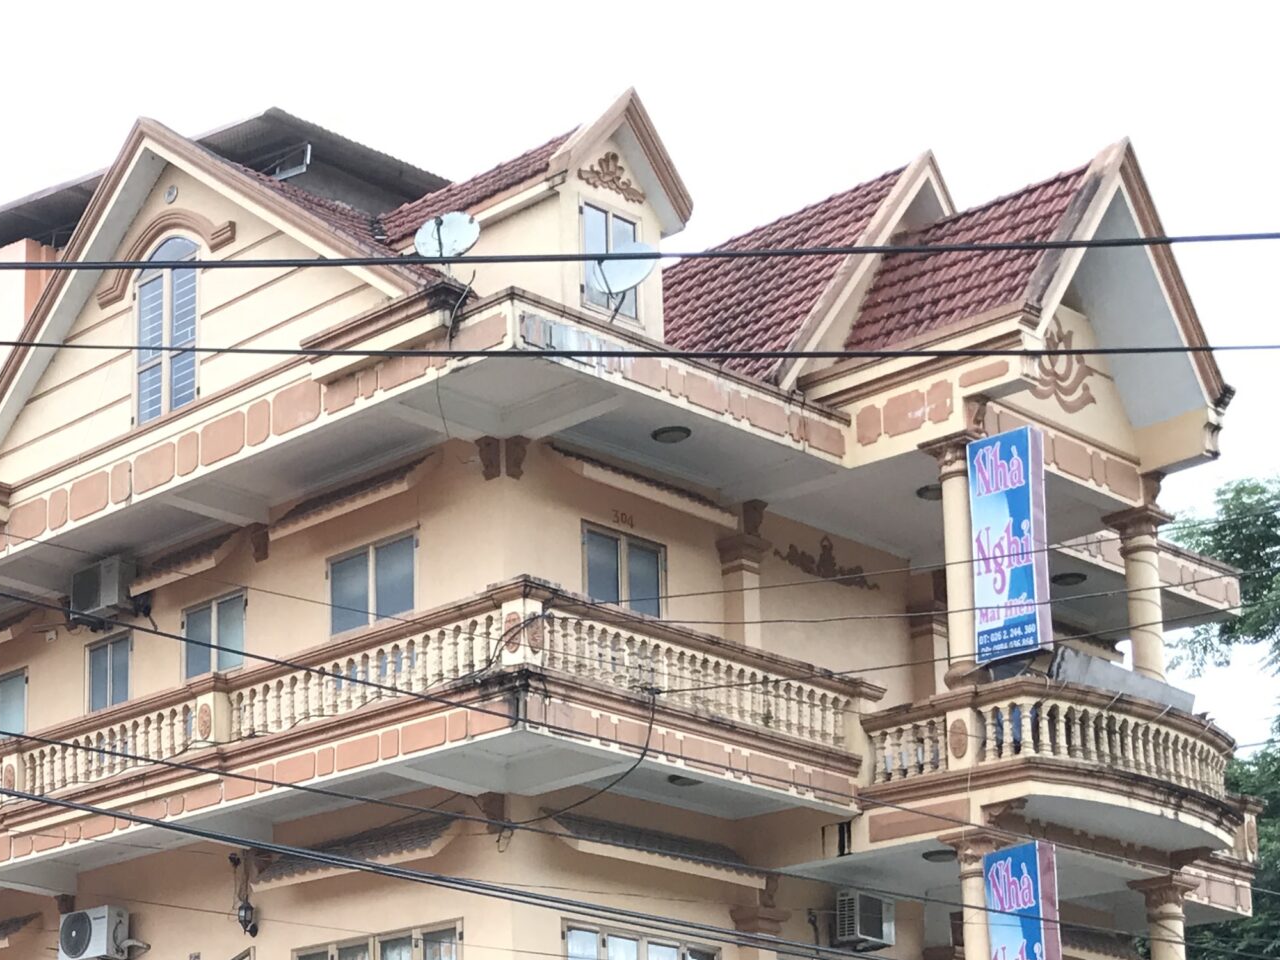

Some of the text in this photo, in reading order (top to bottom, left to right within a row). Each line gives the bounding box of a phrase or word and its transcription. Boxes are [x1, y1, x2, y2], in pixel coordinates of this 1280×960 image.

[973, 440, 1025, 497] Nhà
[611, 509, 634, 529] 304
[975, 518, 1034, 595] Nghỉ
[978, 604, 1001, 625] Mai
[988, 857, 1035, 914] Nhà
